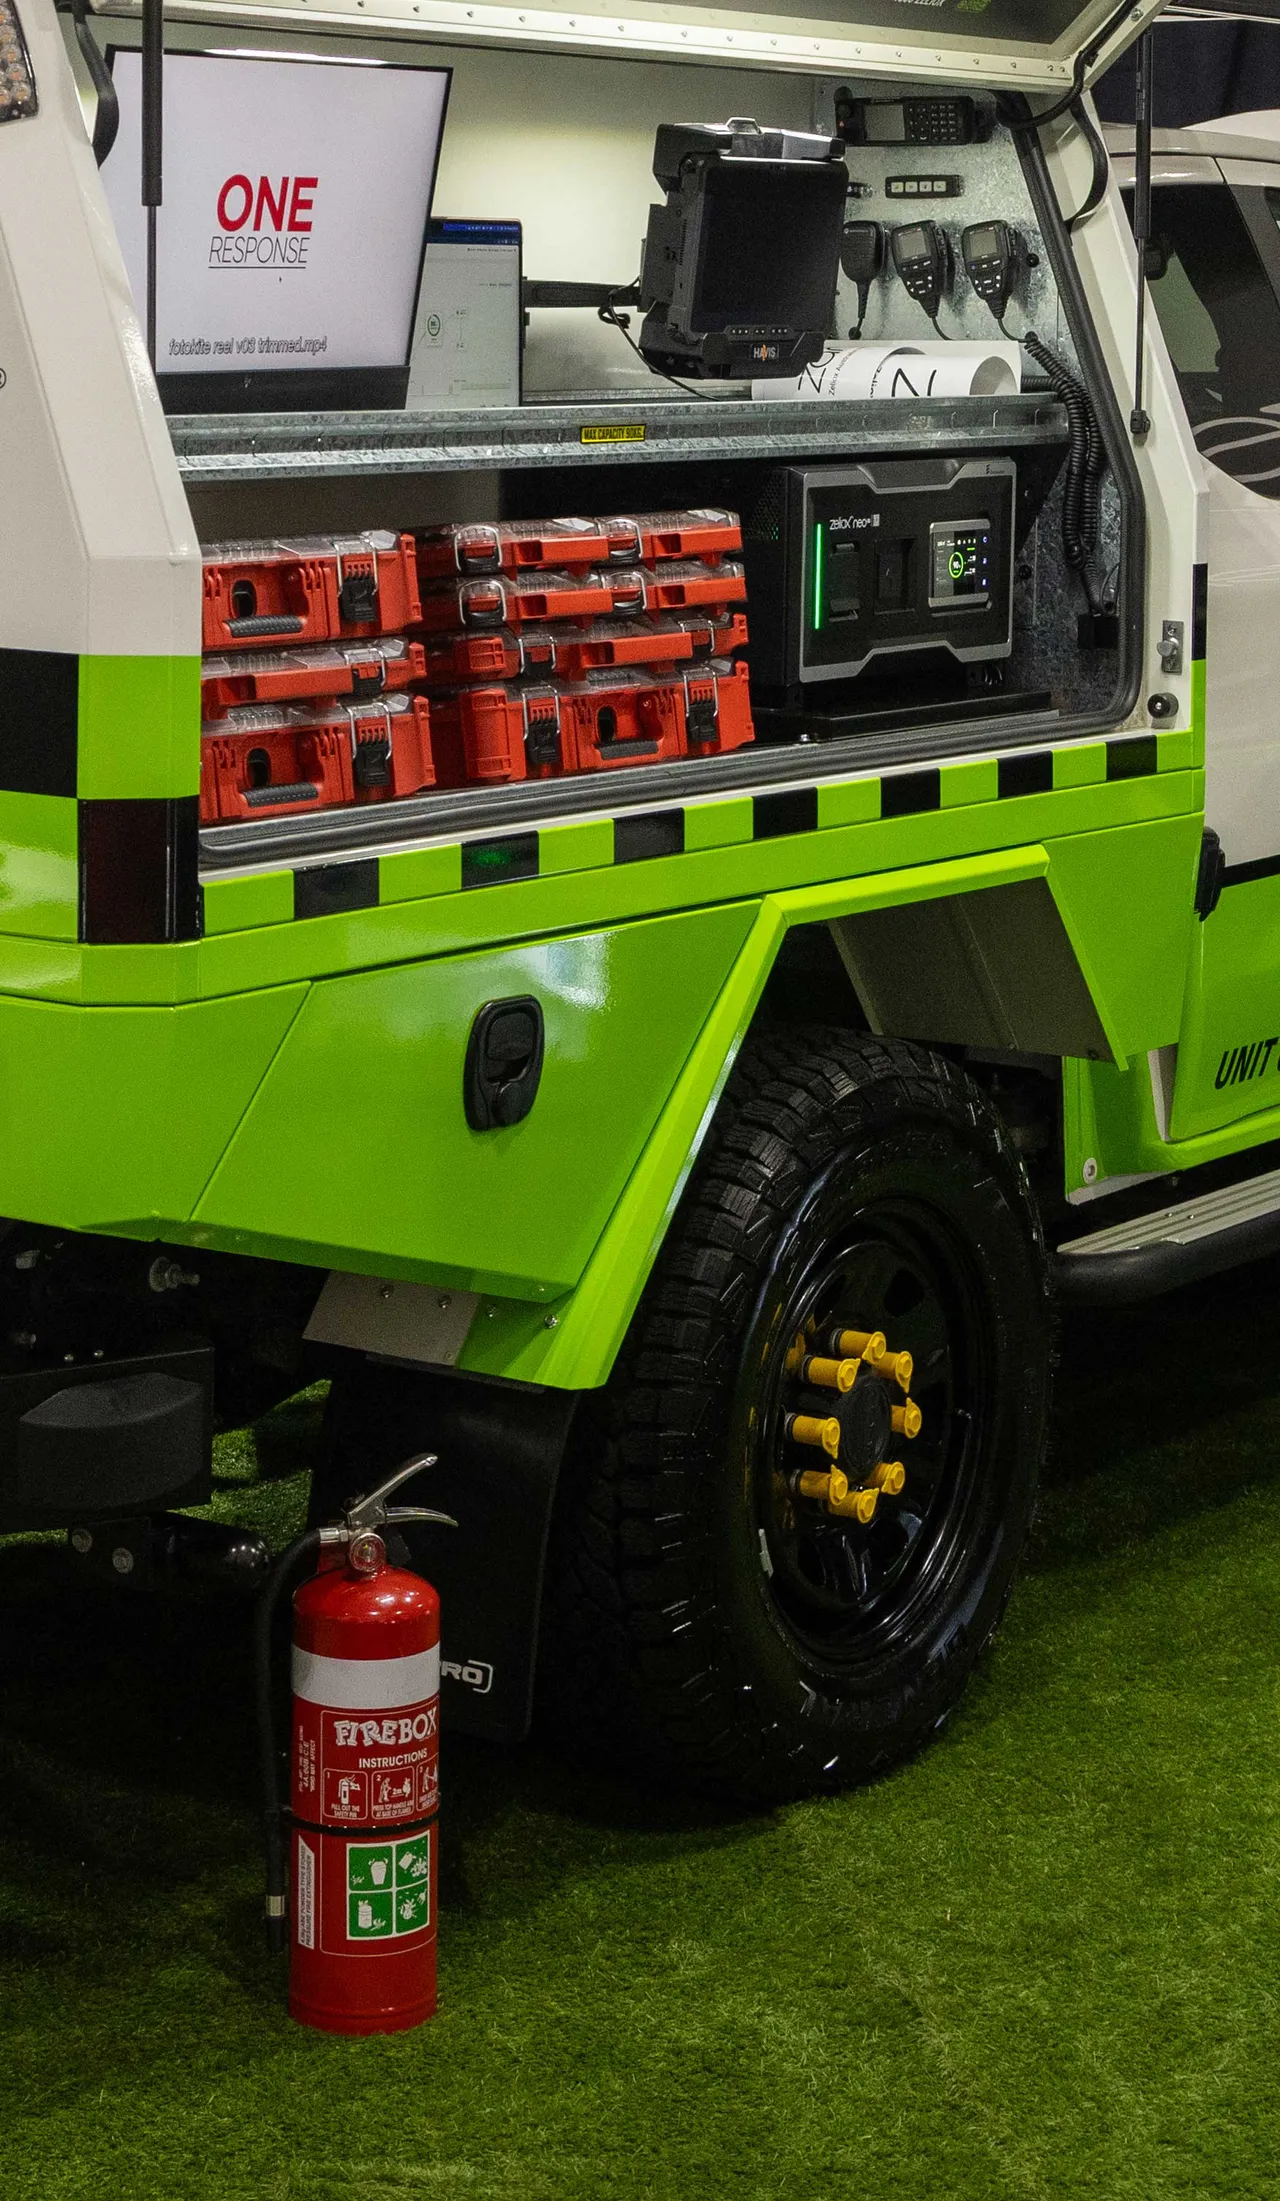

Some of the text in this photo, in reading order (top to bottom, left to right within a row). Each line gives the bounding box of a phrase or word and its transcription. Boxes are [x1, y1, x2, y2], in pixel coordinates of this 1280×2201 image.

[217, 174, 319, 232] ONE
[209, 236, 311, 264] RESPONSE
[169, 335, 328, 357] fotokite reel v03 trimmed.mp4
[753, 346, 776, 361] HAVIS
[1214, 1036, 1280, 1090] UNIT
[440, 1661, 483, 1685] RO
[333, 1706, 437, 1747] FIREBOX
[358, 1748, 428, 1769] INSTRUCTIONS
